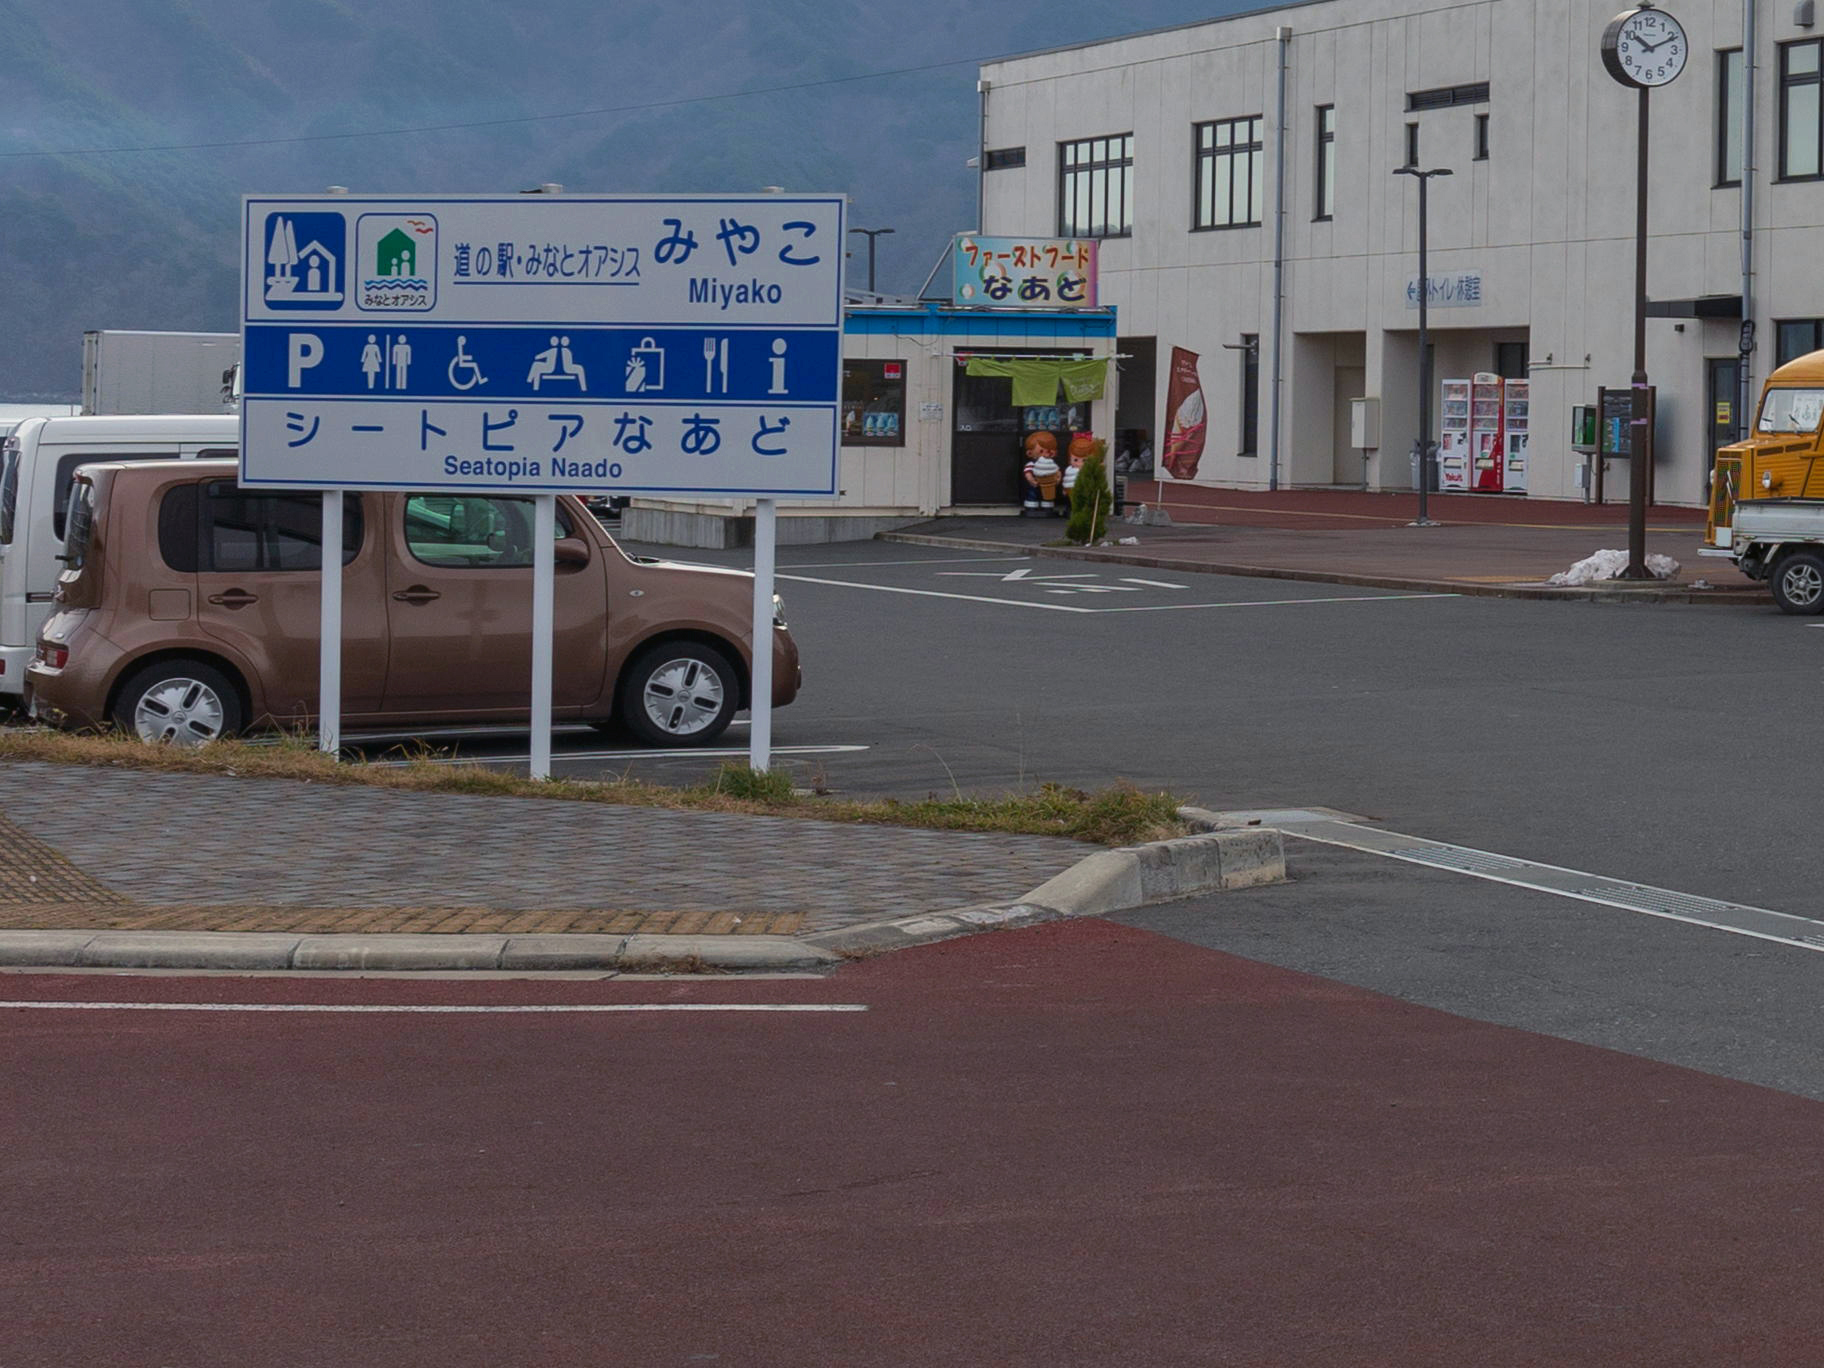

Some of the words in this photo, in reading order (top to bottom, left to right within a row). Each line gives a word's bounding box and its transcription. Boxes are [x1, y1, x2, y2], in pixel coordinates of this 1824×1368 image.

[1632, 20, 1643, 31] 11
[1644, 17, 1656, 28] 12
[1659, 22, 1665, 32] 1
[1624, 31, 1636, 41] 10
[1621, 42, 1629, 52] 9
[1670, 44, 1679, 55] 3
[1625, 55, 1633, 66] 8
[1666, 57, 1674, 68] 4
[1634, 65, 1642, 76] 7
[1645, 69, 1653, 80] 6
[1657, 66, 1665, 77] 5
[654, 218, 820, 267] みやこ
[965, 245, 1089, 269] ファーストフード
[983, 275, 1087, 302] なあど
[689, 278, 782, 311] Miyako
[364, 294, 427, 307] みなとオアシス
[288, 333, 325, 389] P
[444, 455, 541, 479] Seatopia
[551, 458, 622, 478] Naado
